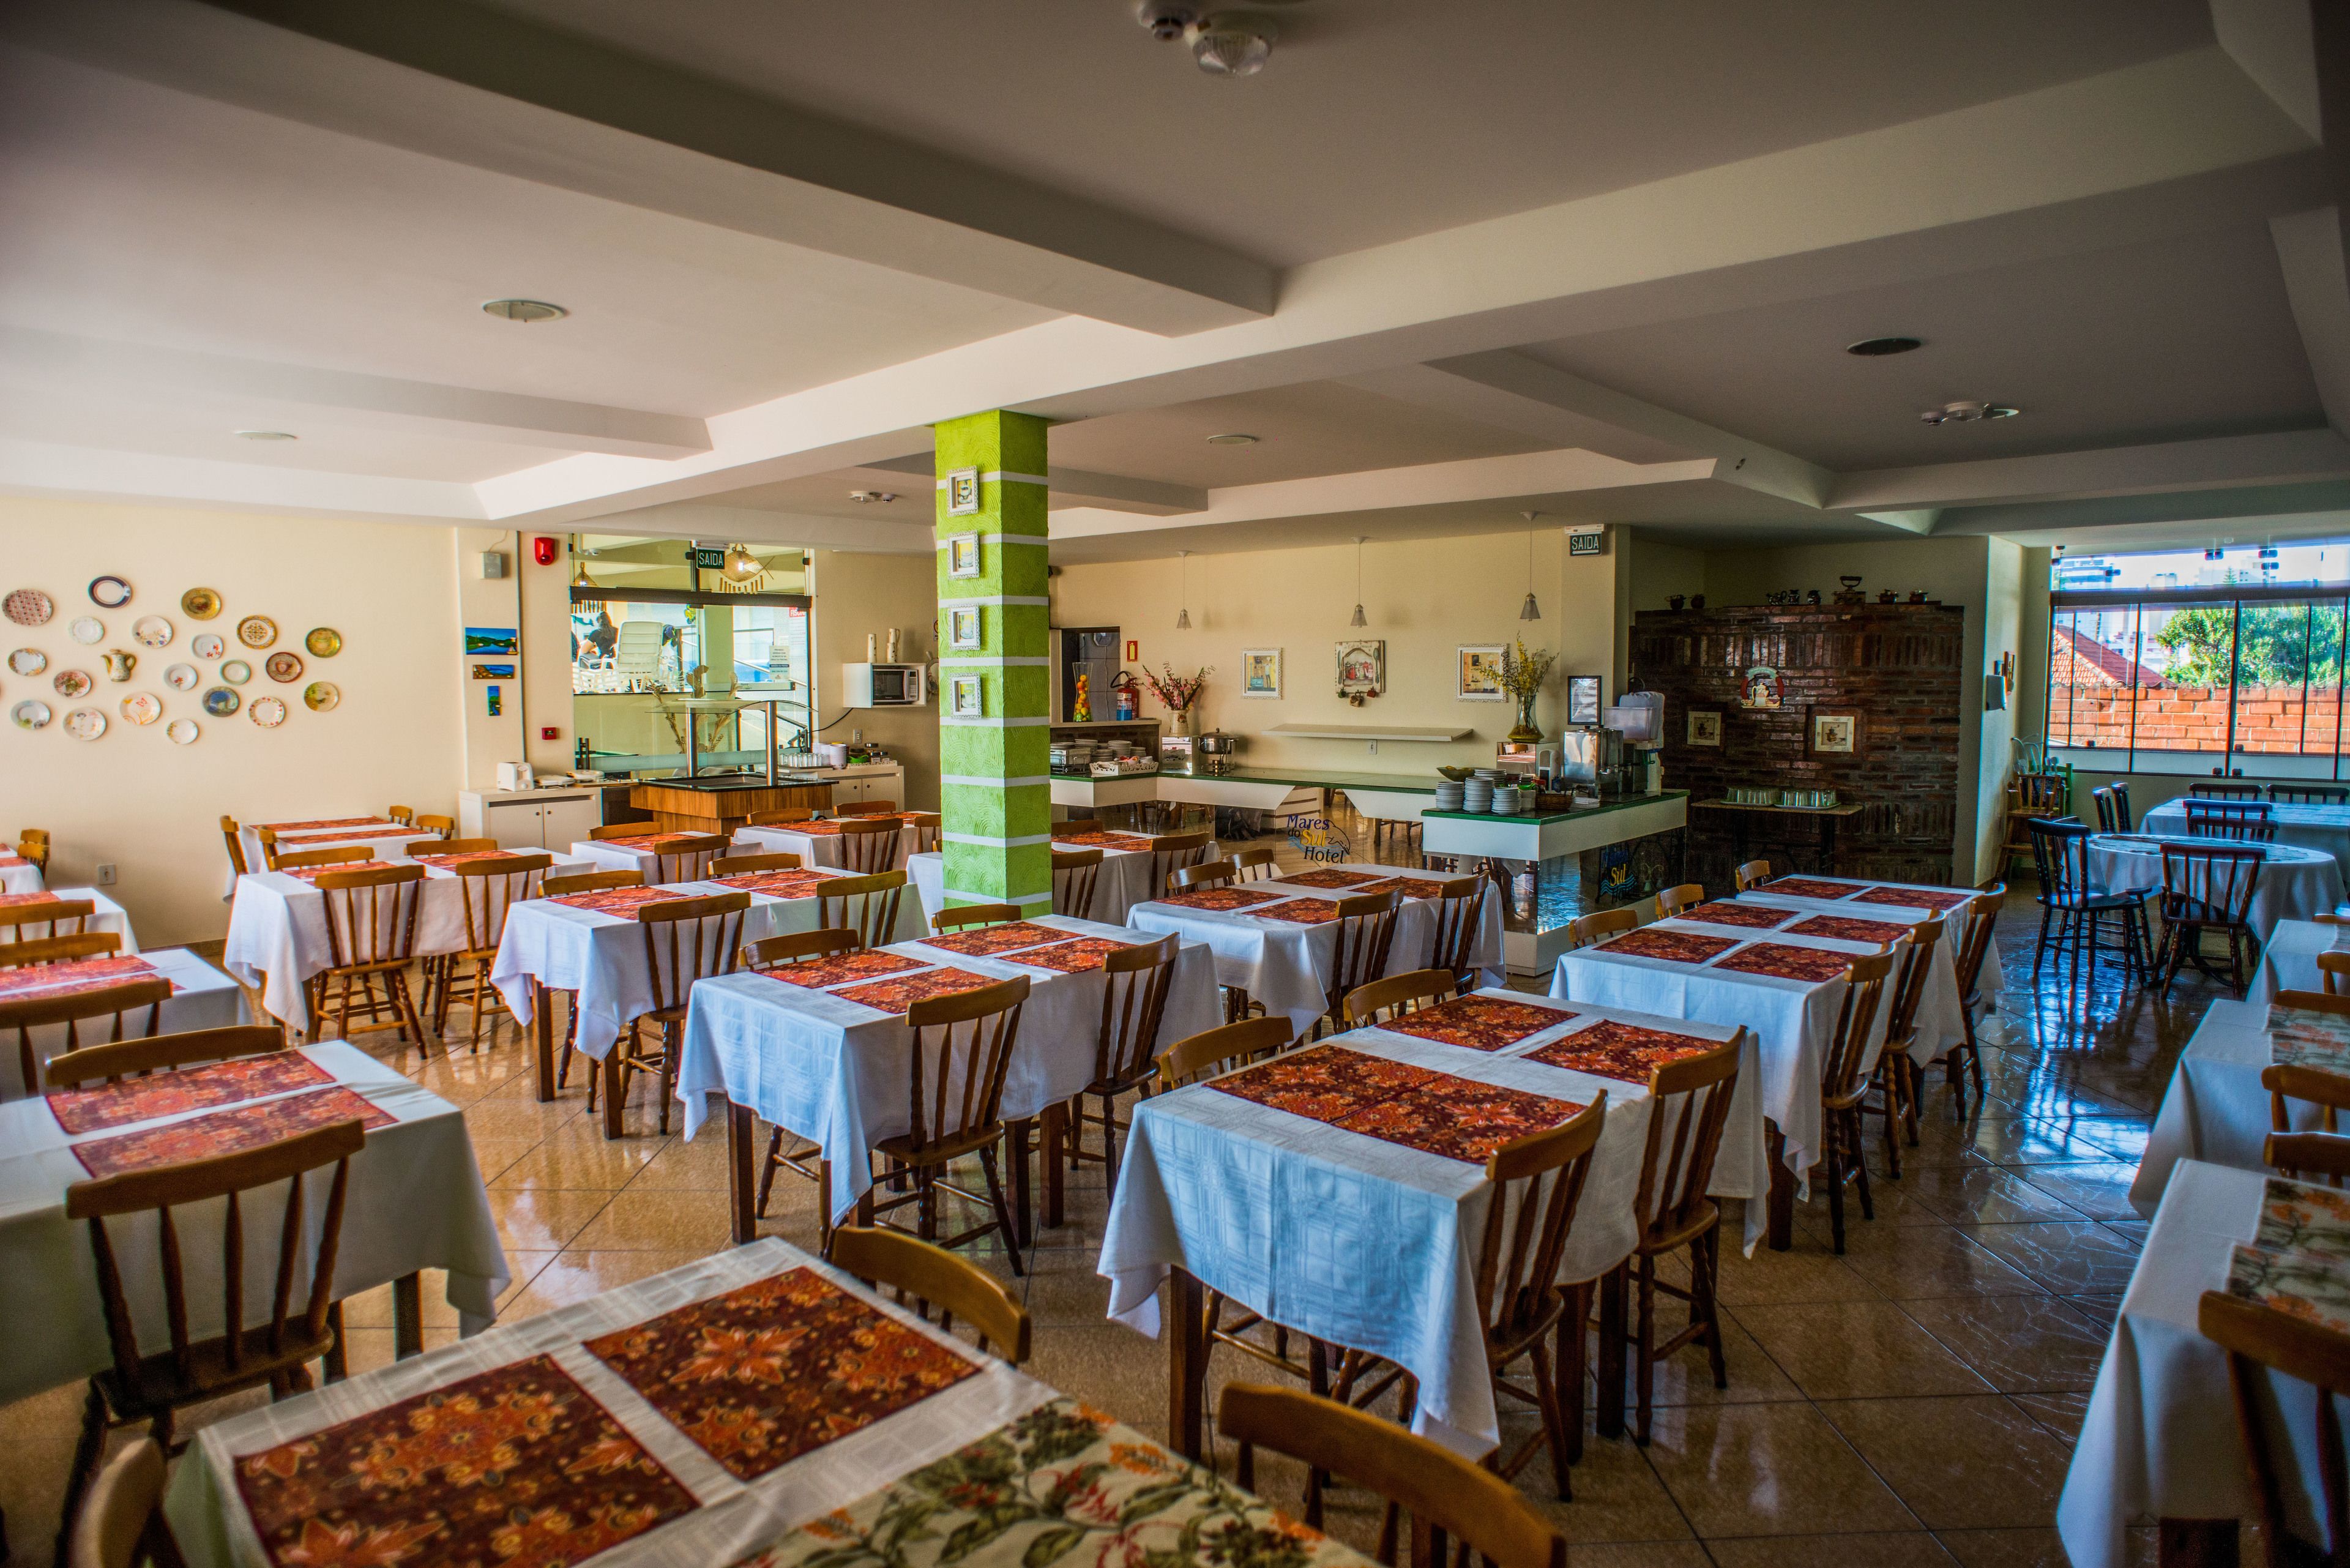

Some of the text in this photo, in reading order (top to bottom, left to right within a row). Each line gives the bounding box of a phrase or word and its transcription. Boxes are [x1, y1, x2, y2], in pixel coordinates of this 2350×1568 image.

[1287, 815, 1329, 830] Mares
[1288, 827, 1326, 847] do Sul
[1304, 846, 1344, 864] Hotel
[1610, 864, 1626, 886] Sul
